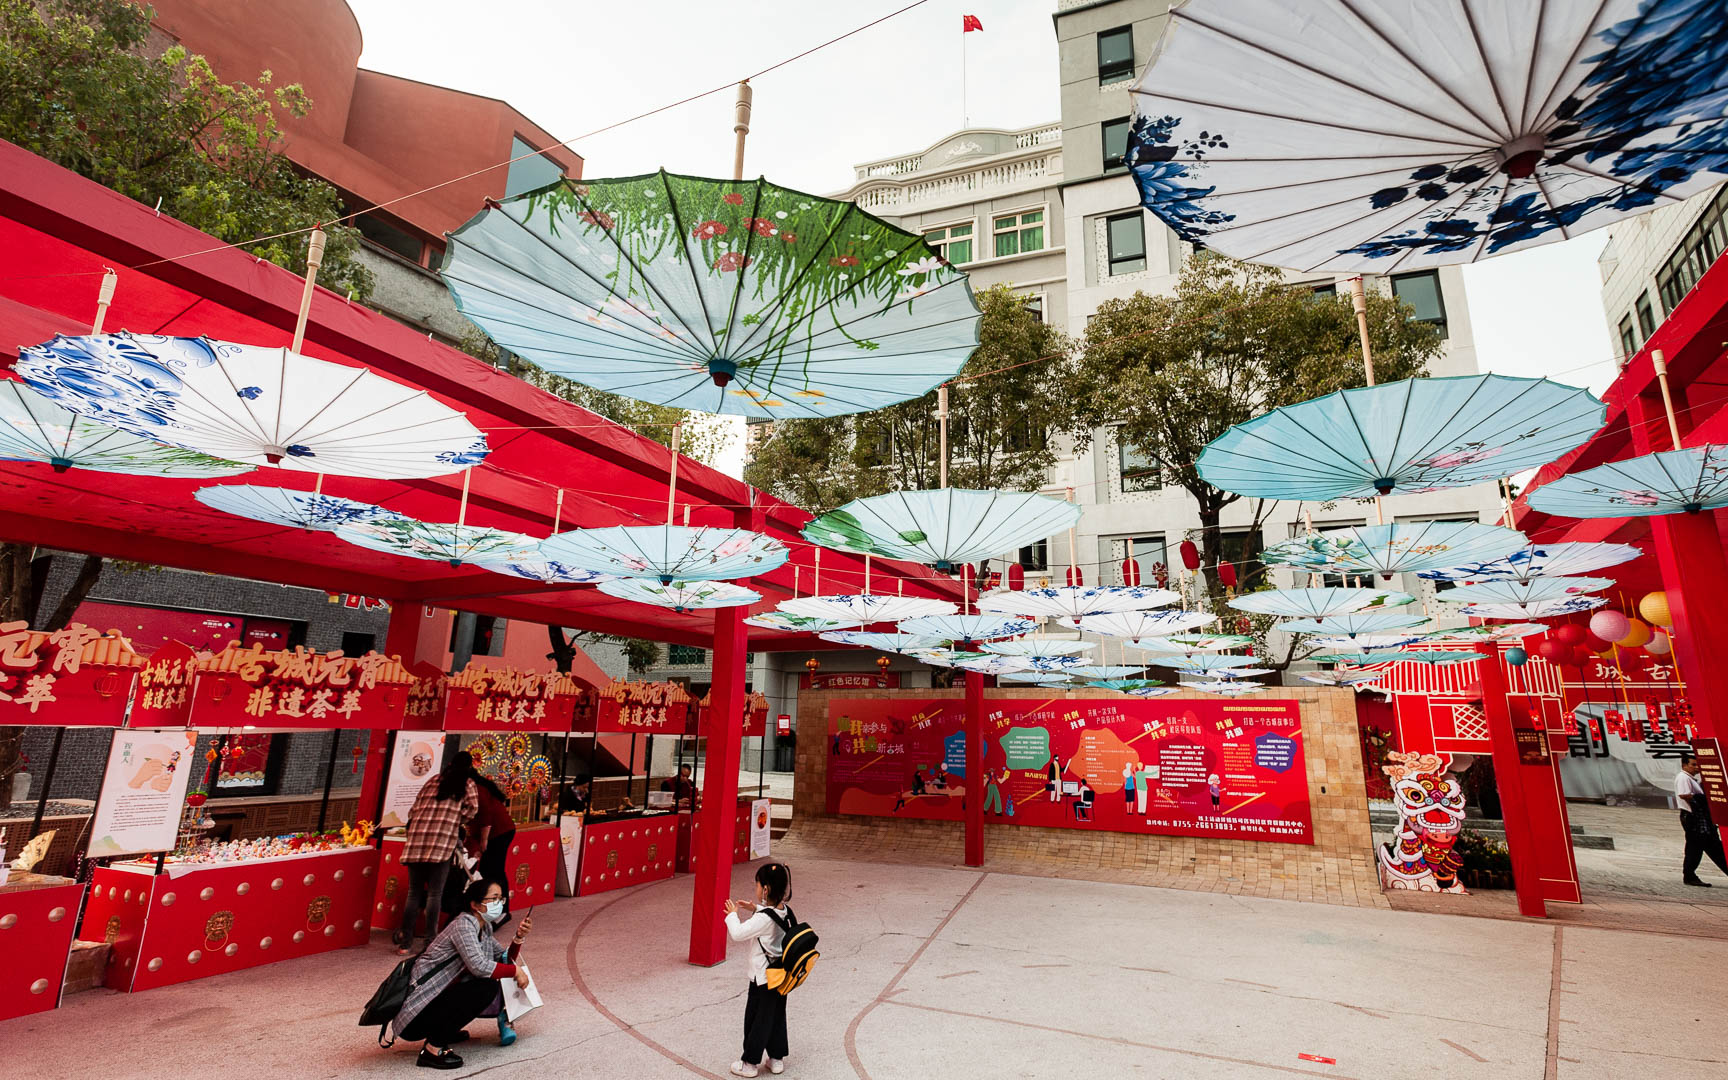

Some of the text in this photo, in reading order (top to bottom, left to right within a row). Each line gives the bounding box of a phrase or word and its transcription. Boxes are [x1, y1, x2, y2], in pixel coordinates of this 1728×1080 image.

[140, 656, 197, 687] 古城元宵
[234, 642, 393, 690] 古城元宵
[472, 664, 563, 700] 古城元宵
[614, 678, 677, 708] 古城元宵
[828, 677, 870, 687] 红色记忆馆
